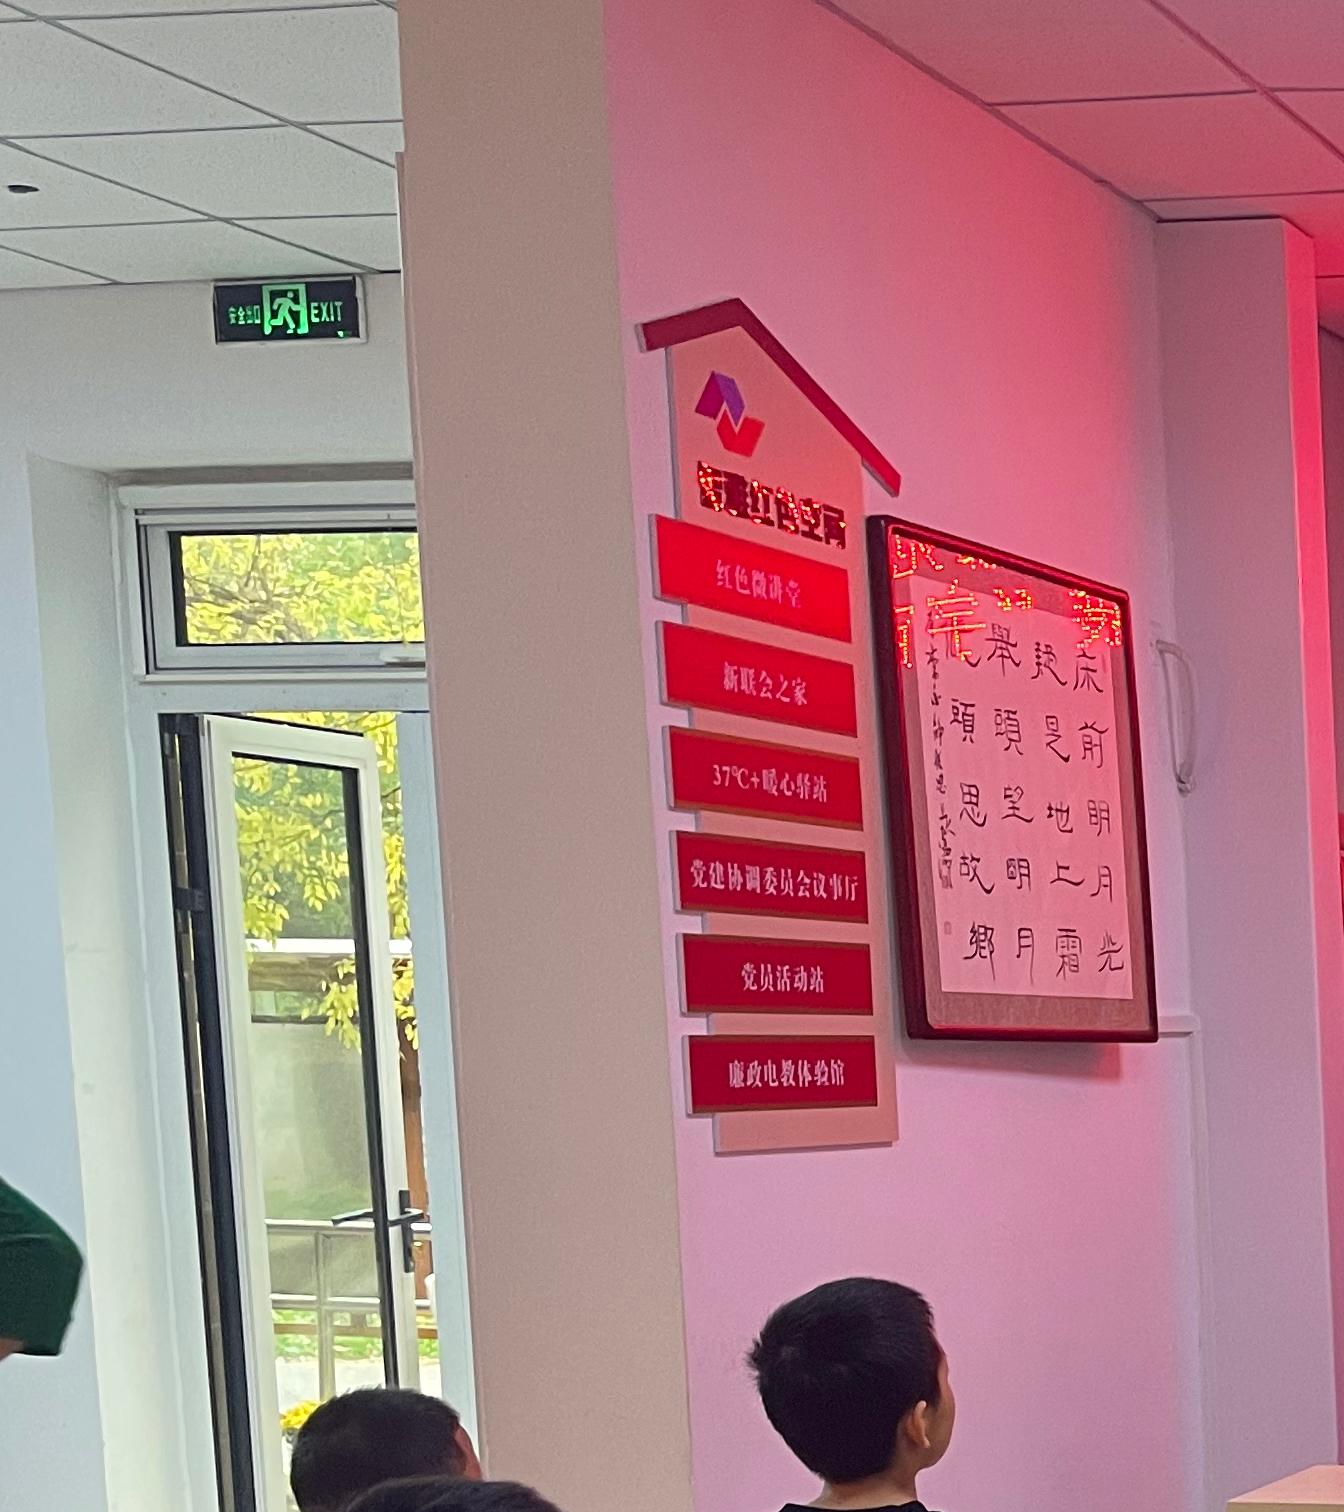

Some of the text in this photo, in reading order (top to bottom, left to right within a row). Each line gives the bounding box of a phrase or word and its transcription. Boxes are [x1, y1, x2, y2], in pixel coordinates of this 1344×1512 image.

[310, 301, 343, 323] EXIT
[723, 660, 808, 706] 新联会之家
[690, 858, 858, 902] 党建协调委员会议事厅
[741, 962, 825, 994] 党员活动站
[728, 1058, 845, 1089] 廉政电教体验馆
